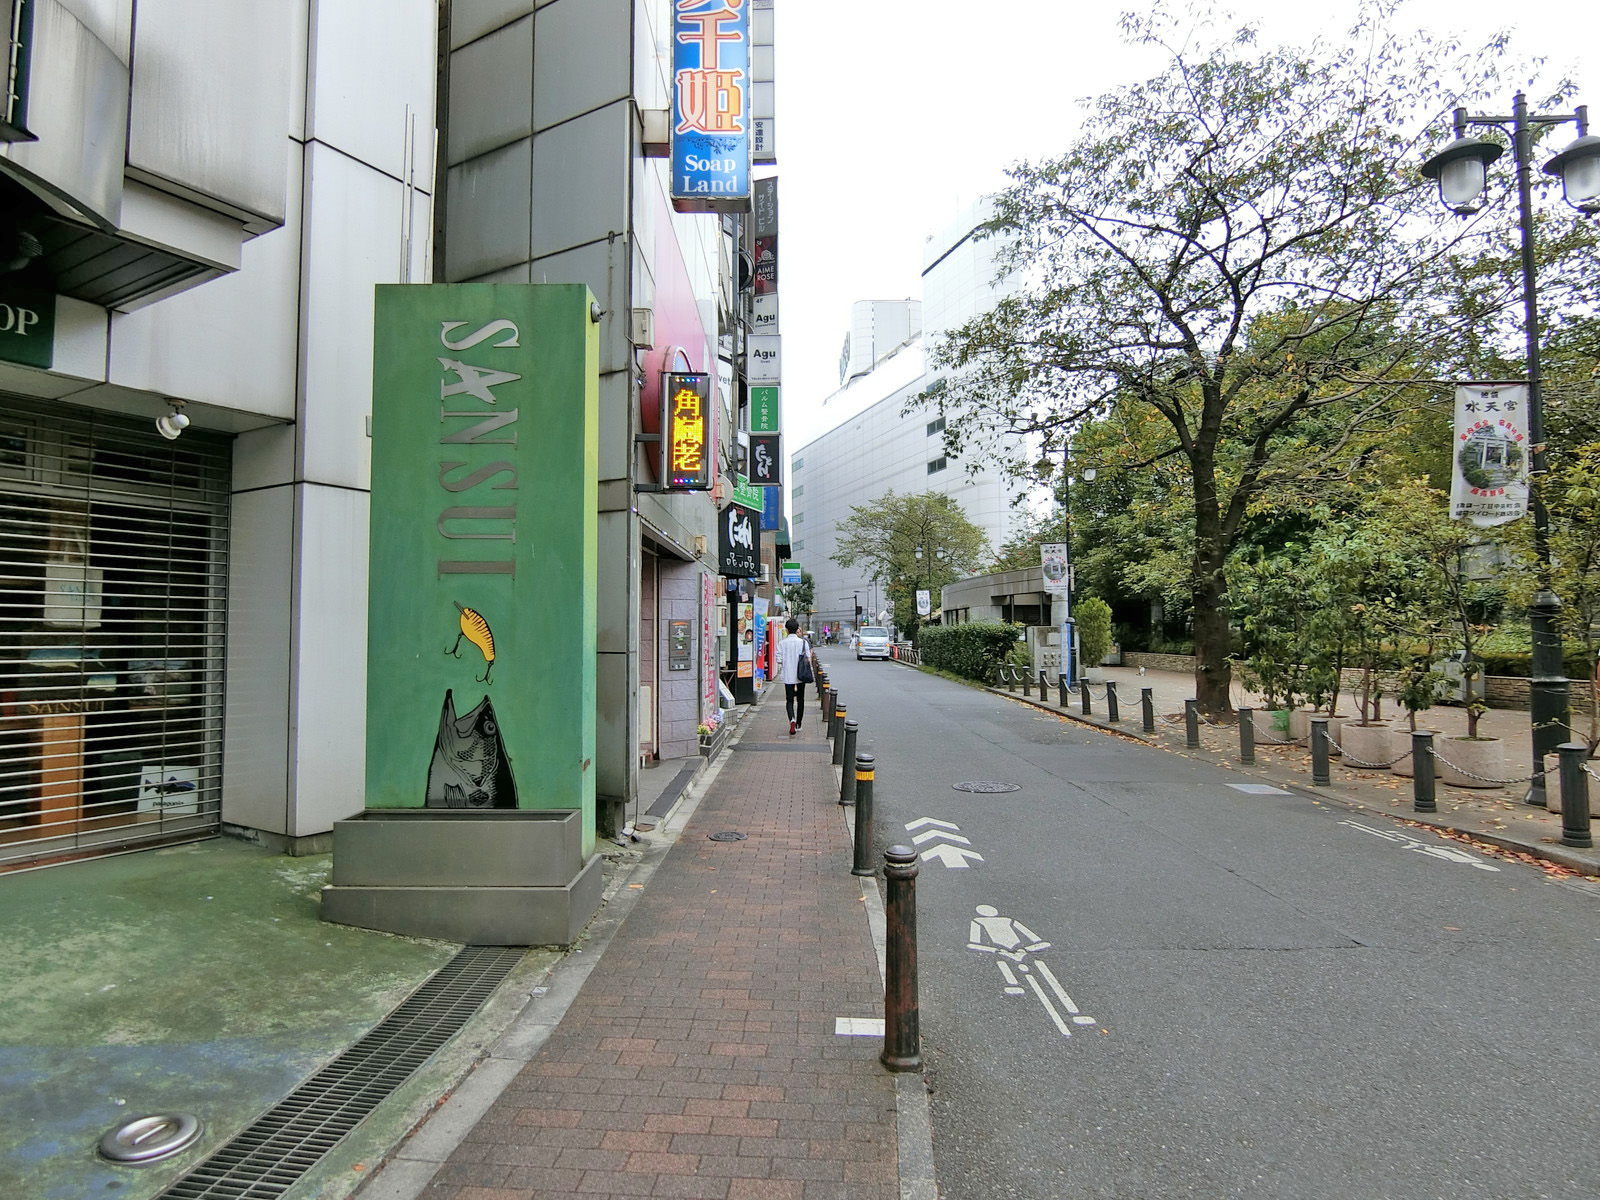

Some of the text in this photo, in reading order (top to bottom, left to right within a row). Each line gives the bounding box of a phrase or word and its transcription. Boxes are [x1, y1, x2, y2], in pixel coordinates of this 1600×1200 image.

[677, 0, 743, 132] 千姫
[684, 154, 737, 174] Soap
[682, 175, 739, 193] Land
[757, 266, 775, 275] AIME
[757, 273, 775, 281] ROSE
[0, 303, 39, 336] OP
[756, 314, 775, 323] Agu
[753, 349, 776, 360] Agu
[1464, 400, 1518, 413] 水天宮
[436, 319, 522, 581] SANSUI
